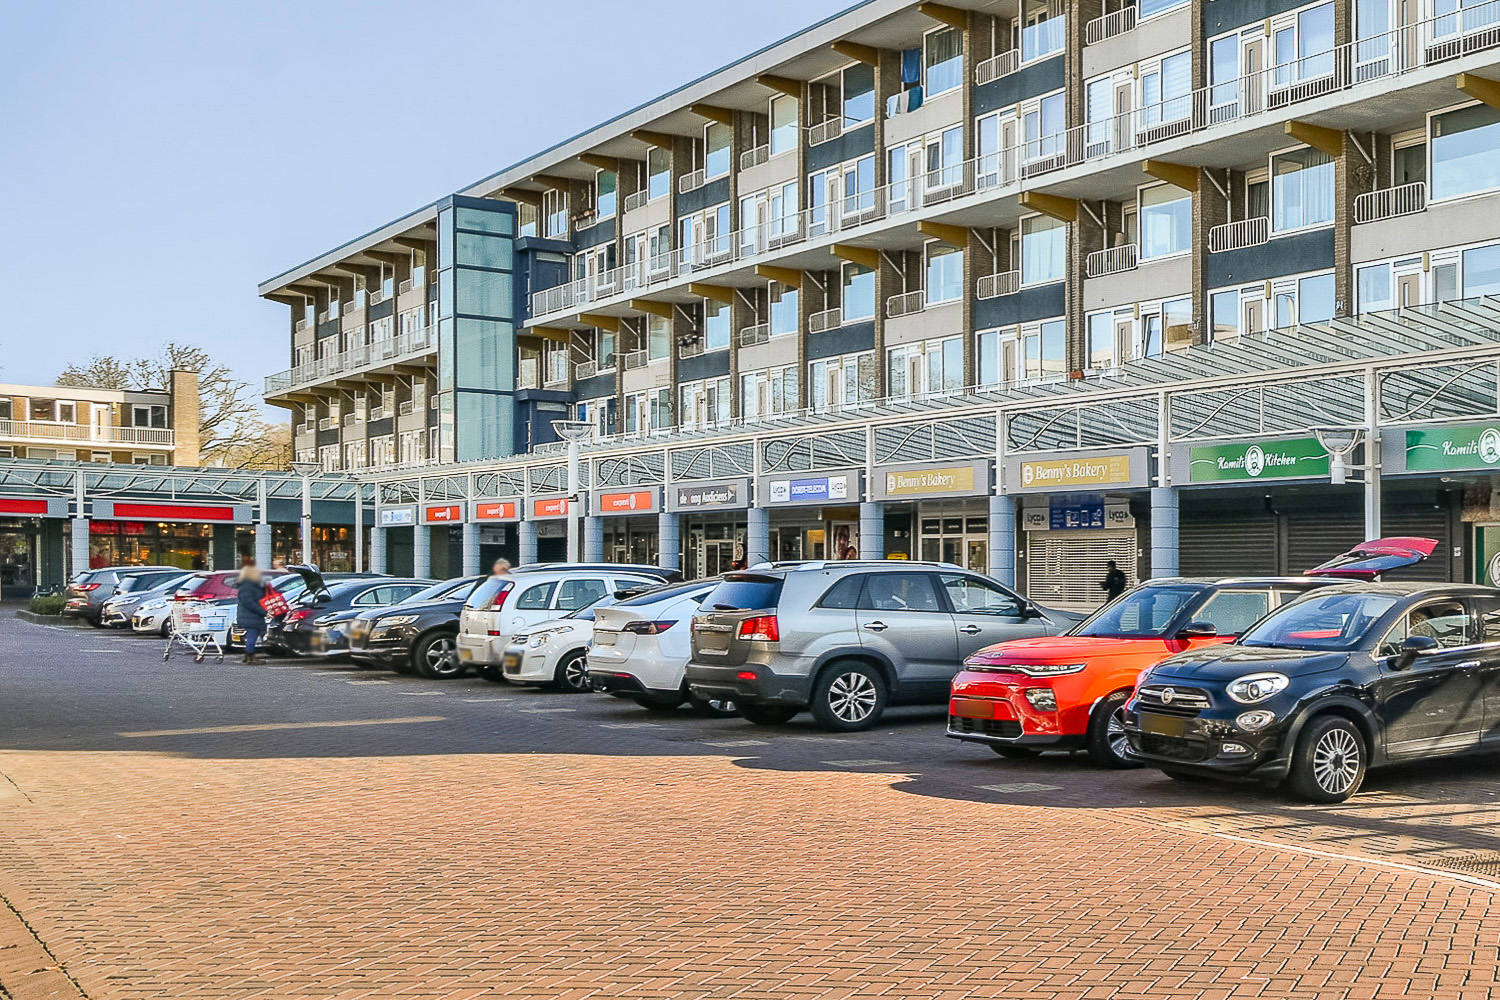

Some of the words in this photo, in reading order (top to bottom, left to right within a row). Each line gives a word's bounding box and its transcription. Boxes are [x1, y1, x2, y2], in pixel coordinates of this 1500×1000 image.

[1442, 440, 1479, 456] Kamil's
[1217, 455, 1246, 470] Kamil's
[1264, 453, 1297, 467] Kitchen
[1035, 464, 1072, 482] Benny's
[1072, 462, 1108, 480] Bakery
[897, 474, 927, 490] Benny's
[927, 472, 955, 489] Bakery
